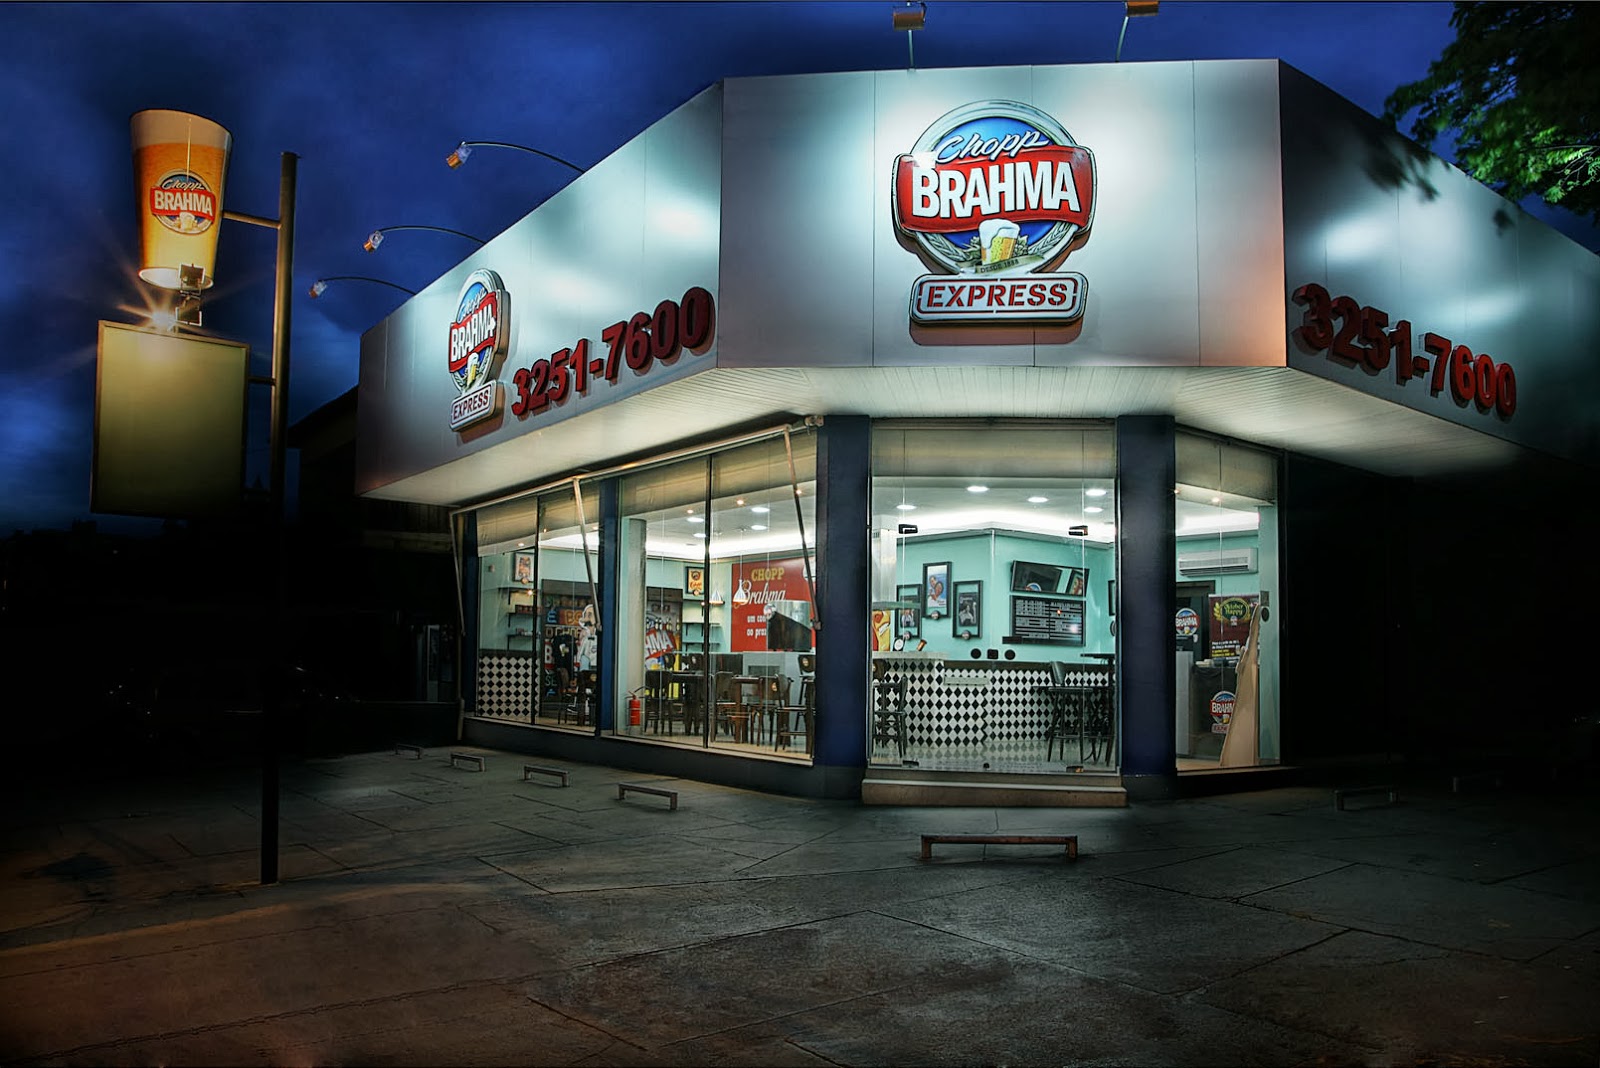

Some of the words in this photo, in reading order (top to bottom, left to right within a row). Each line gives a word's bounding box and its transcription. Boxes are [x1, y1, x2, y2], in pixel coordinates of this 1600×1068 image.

[935, 130, 1050, 164] Chopp
[161, 179, 205, 191] Chopp
[911, 160, 1081, 219] BRAHMA
[154, 189, 213, 217] BRAHMA
[926, 283, 1068, 308] EXPRESS
[450, 303, 497, 362] BRAHMA
[511, 286, 716, 418] 3251-7600
[1291, 283, 1517, 418] 3251-7600
[453, 389, 489, 421] EXPRESS
[751, 567, 785, 582] CHOPP
